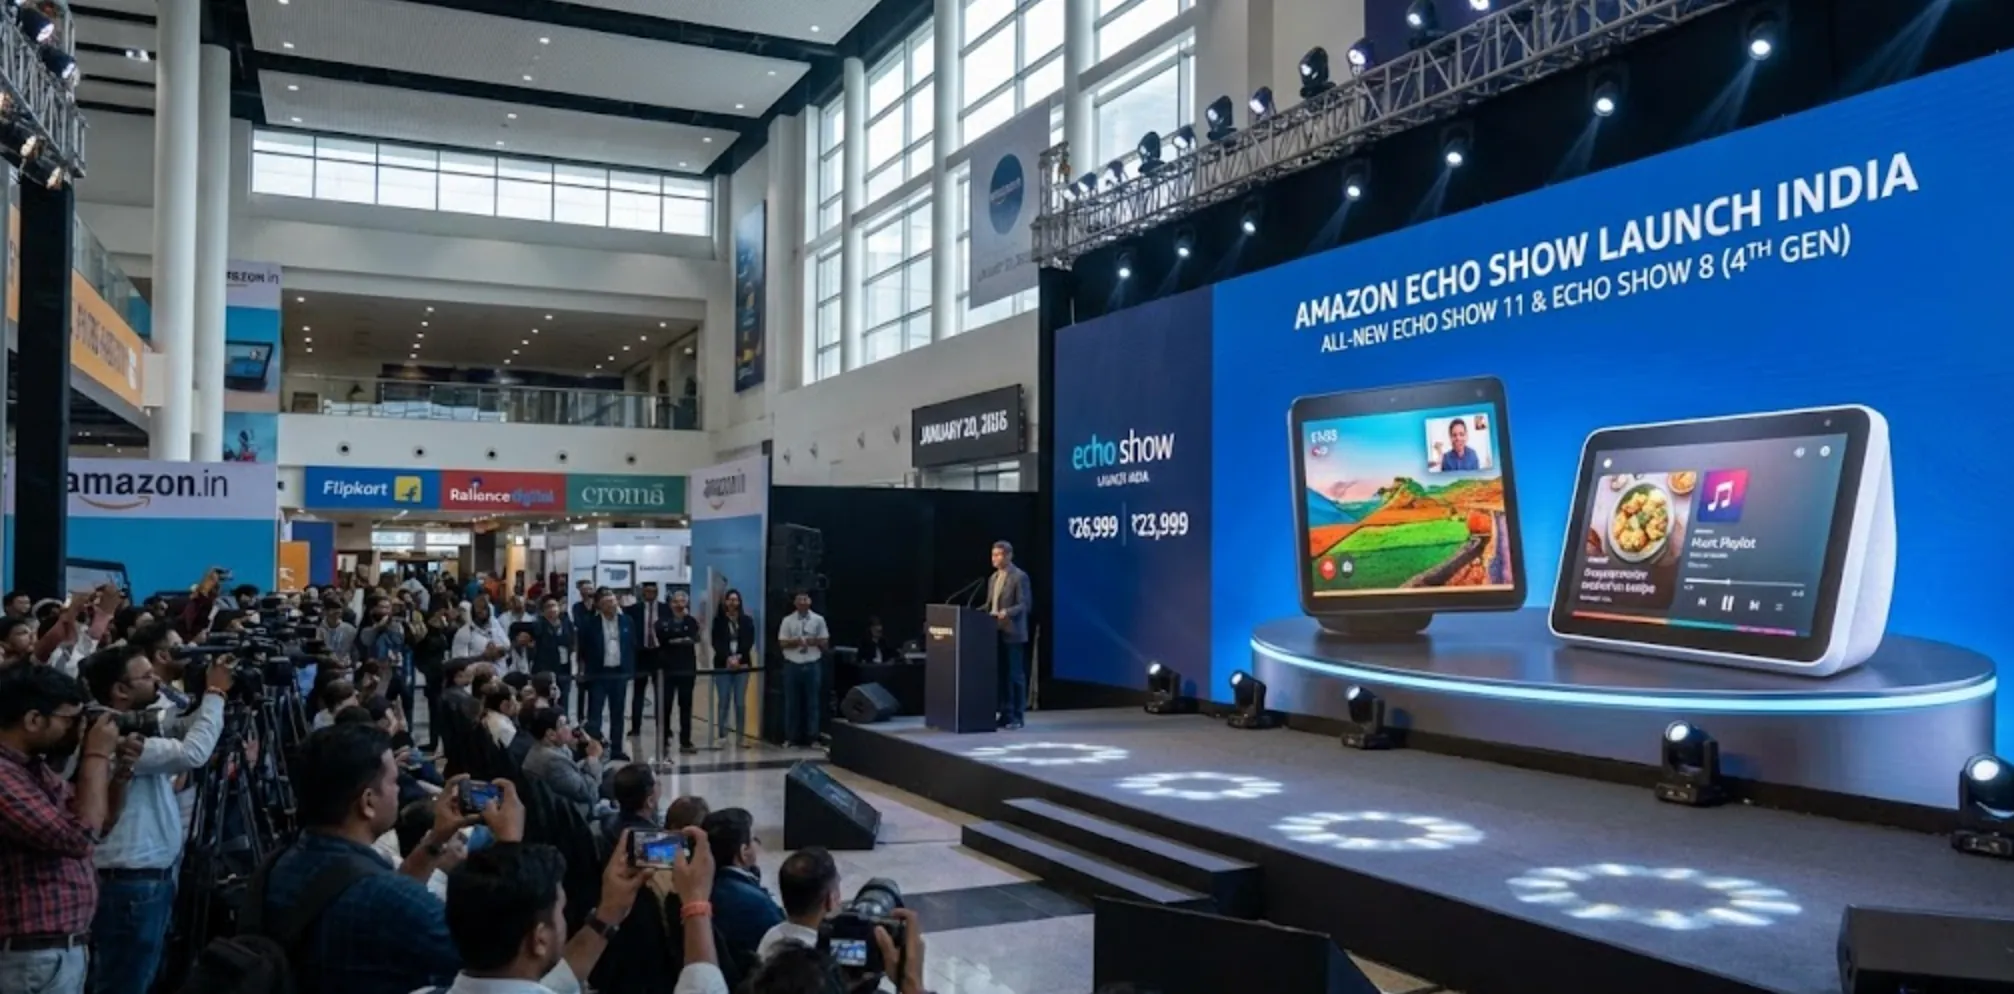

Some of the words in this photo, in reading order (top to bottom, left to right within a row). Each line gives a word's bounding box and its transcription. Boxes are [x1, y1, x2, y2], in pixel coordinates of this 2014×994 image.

[1294, 279, 1398, 330] AMAZON
[1406, 260, 1481, 305] ECHO
[1489, 232, 1589, 287] SHOW
[1599, 189, 1761, 262] LAUNCH
[1777, 152, 1919, 222] INDIA
[1320, 322, 1389, 353] ALL-NEW
[1393, 312, 1438, 340] ECHO
[1441, 300, 1498, 331] SHOW
[1503, 294, 1524, 318] 11
[1531, 290, 1547, 313] &
[1553, 276, 1611, 309] ECHO
[1617, 258, 1692, 297] SHOW
[1699, 253, 1714, 279] 8
[1780, 222, 1851, 263] GEN)
[1072, 433, 1117, 470] echo
[1119, 428, 1175, 464] show
[323, 480, 388, 498] Flipkart
[1131, 511, 1189, 541] ₹23,999
